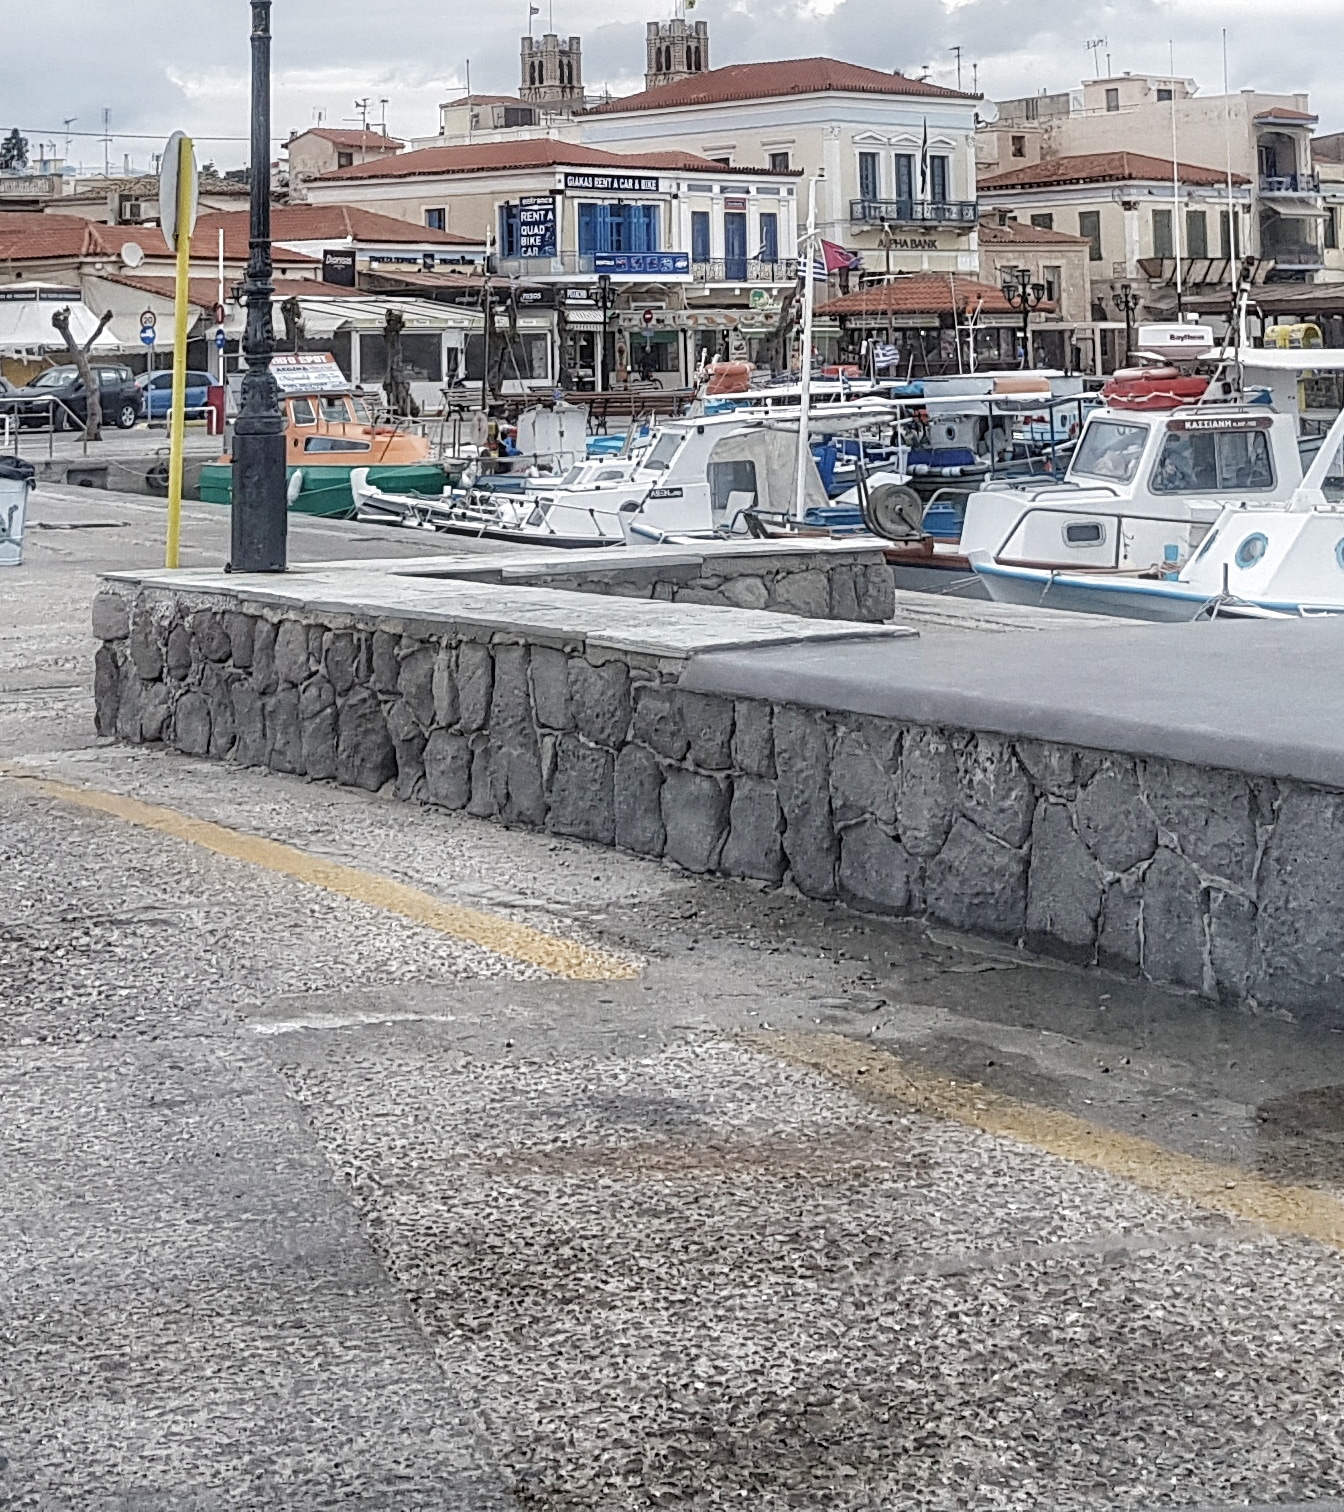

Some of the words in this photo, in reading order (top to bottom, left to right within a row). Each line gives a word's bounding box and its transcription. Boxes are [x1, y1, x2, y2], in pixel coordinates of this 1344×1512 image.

[567, 176, 593, 187] GIAKAS
[594, 177, 612, 188] RENT
[613, 178, 618, 188] A
[619, 178, 633, 189] CAR
[634, 179, 640, 189] &
[641, 179, 657, 190] BIKE
[522, 197, 553, 205] entrance
[521, 210, 545, 222] RENT
[546, 210, 554, 221] A
[521, 224, 545, 236] QUAD
[521, 235, 542, 246] BIKE
[910, 239, 937, 248] BANK
[521, 247, 539, 257] CAR
[144, 316, 153, 324] 20
